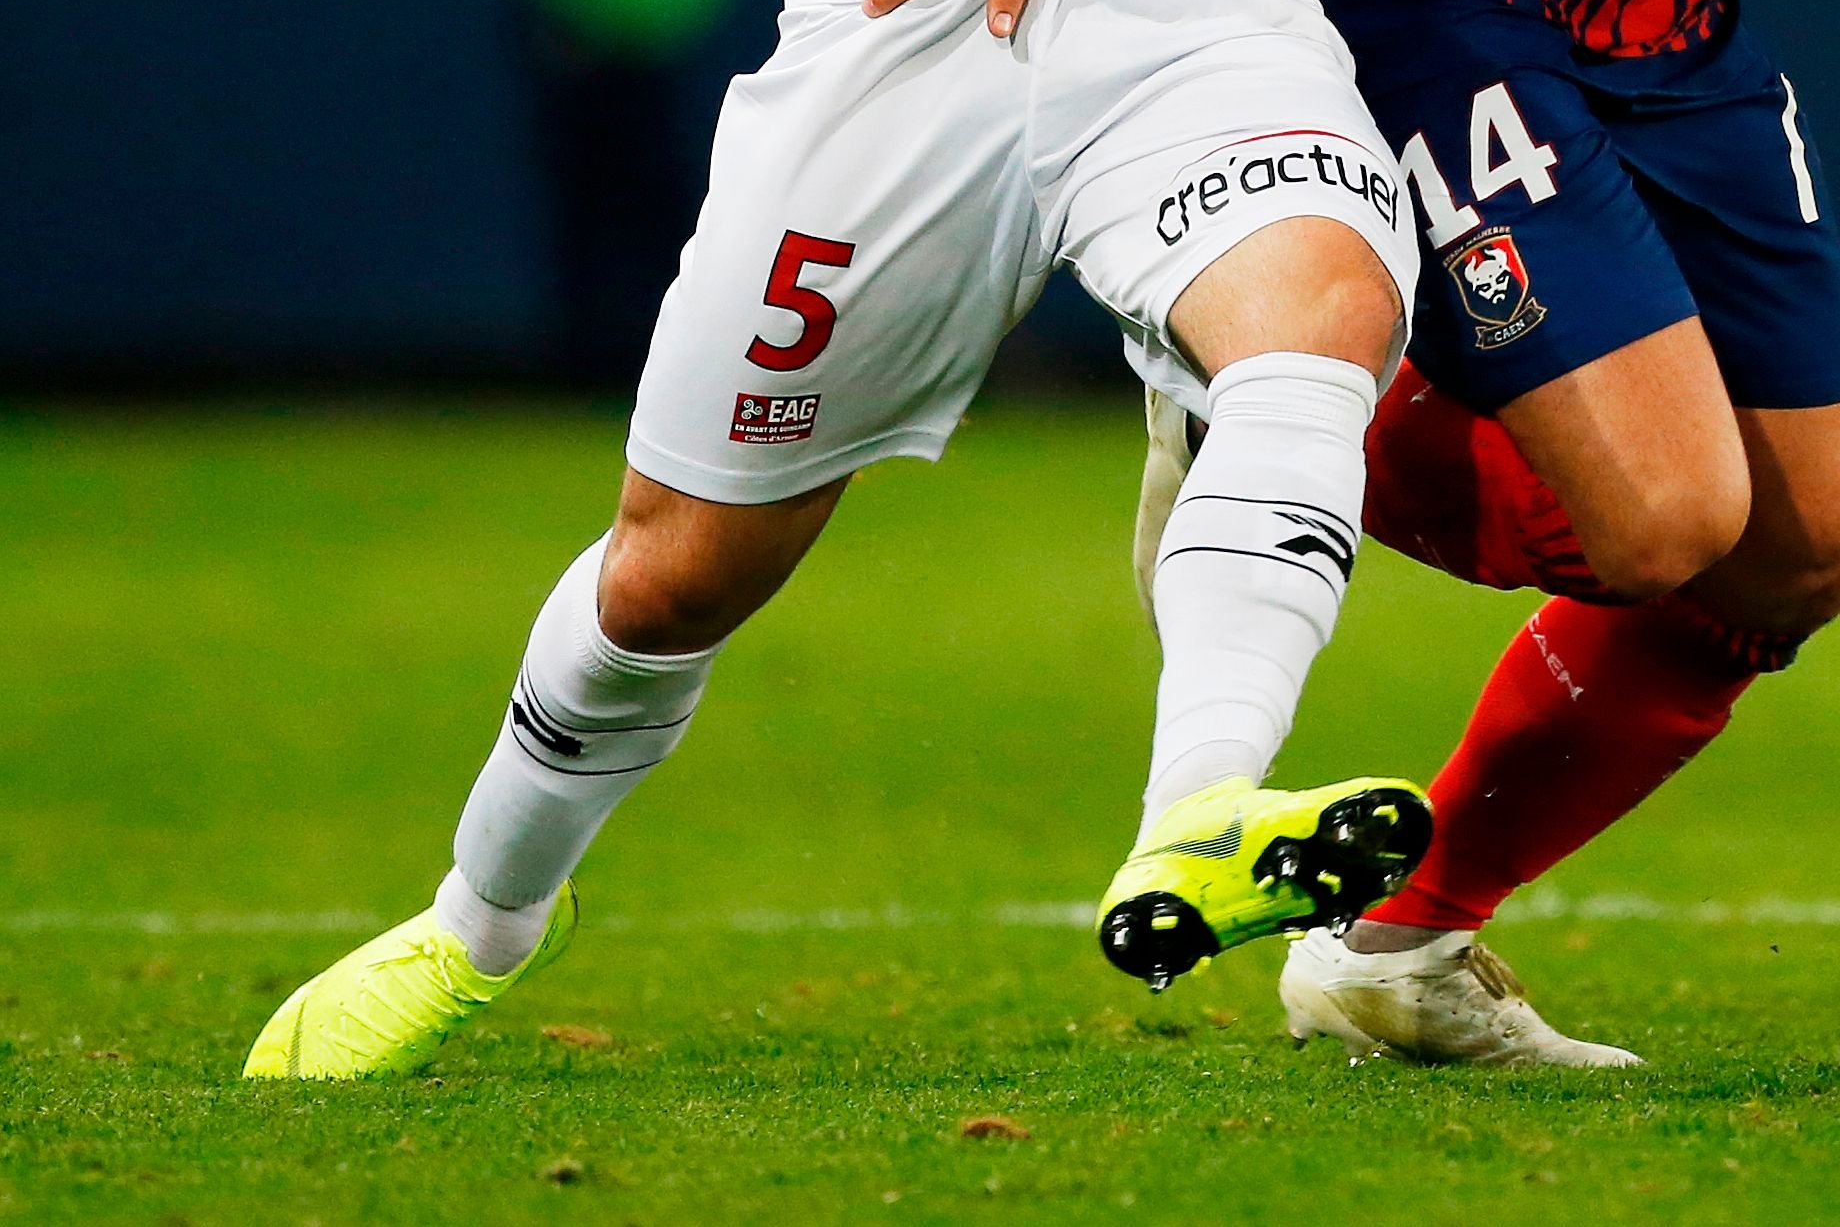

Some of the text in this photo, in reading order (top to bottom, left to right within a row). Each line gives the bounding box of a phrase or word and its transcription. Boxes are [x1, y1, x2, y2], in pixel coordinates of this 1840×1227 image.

[1399, 81, 1559, 251] 14
[744, 229, 856, 373] 5
[1494, 318, 1526, 342] CAEN
[767, 398, 817, 423] EAG
